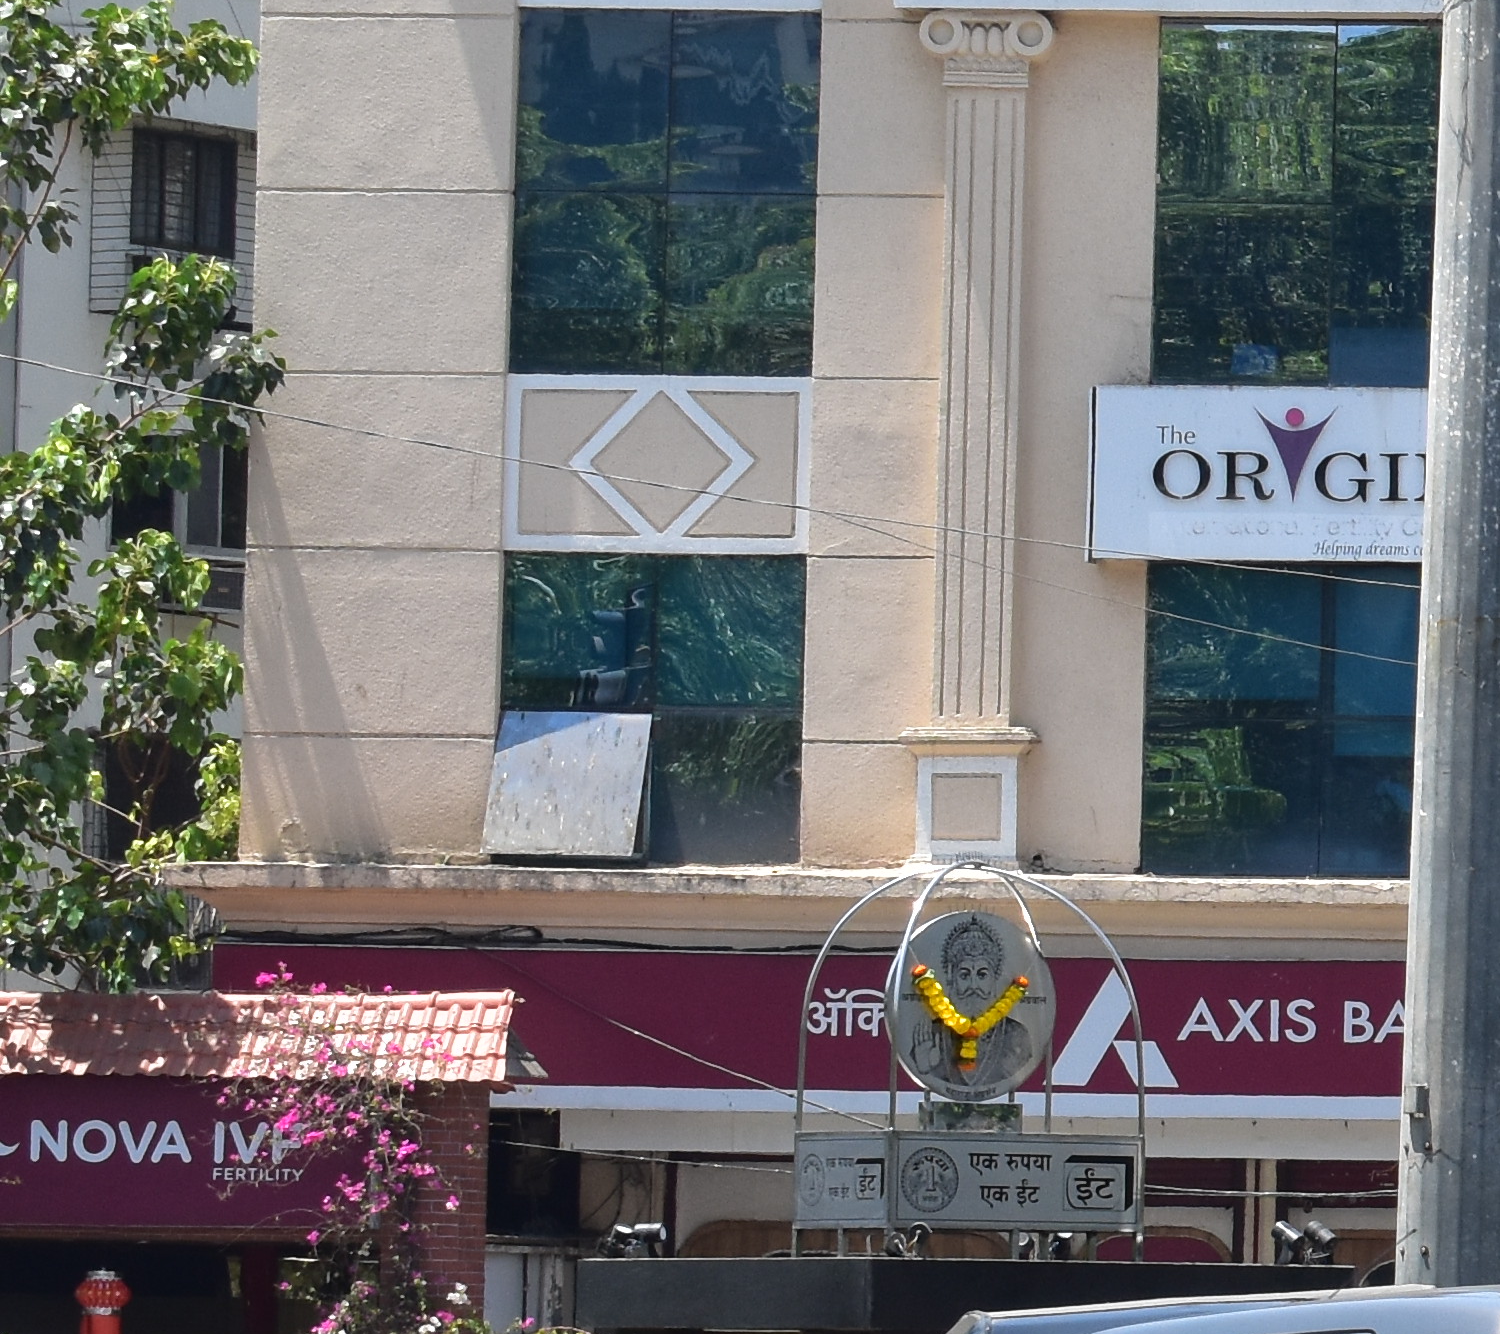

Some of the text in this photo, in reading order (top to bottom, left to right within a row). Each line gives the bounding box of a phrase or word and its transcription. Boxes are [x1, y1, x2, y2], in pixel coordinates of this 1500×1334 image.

[1156, 425, 1197, 445] The
[1312, 539, 1410, 560] Helping dreams
[1177, 995, 1406, 1045] AXIS BA
[29, 1119, 193, 1164] NOVA
[212, 1167, 304, 1182] FERTILITY
[968, 1153, 1053, 1176] एक रुपया
[980, 1185, 1010, 1208] एक
